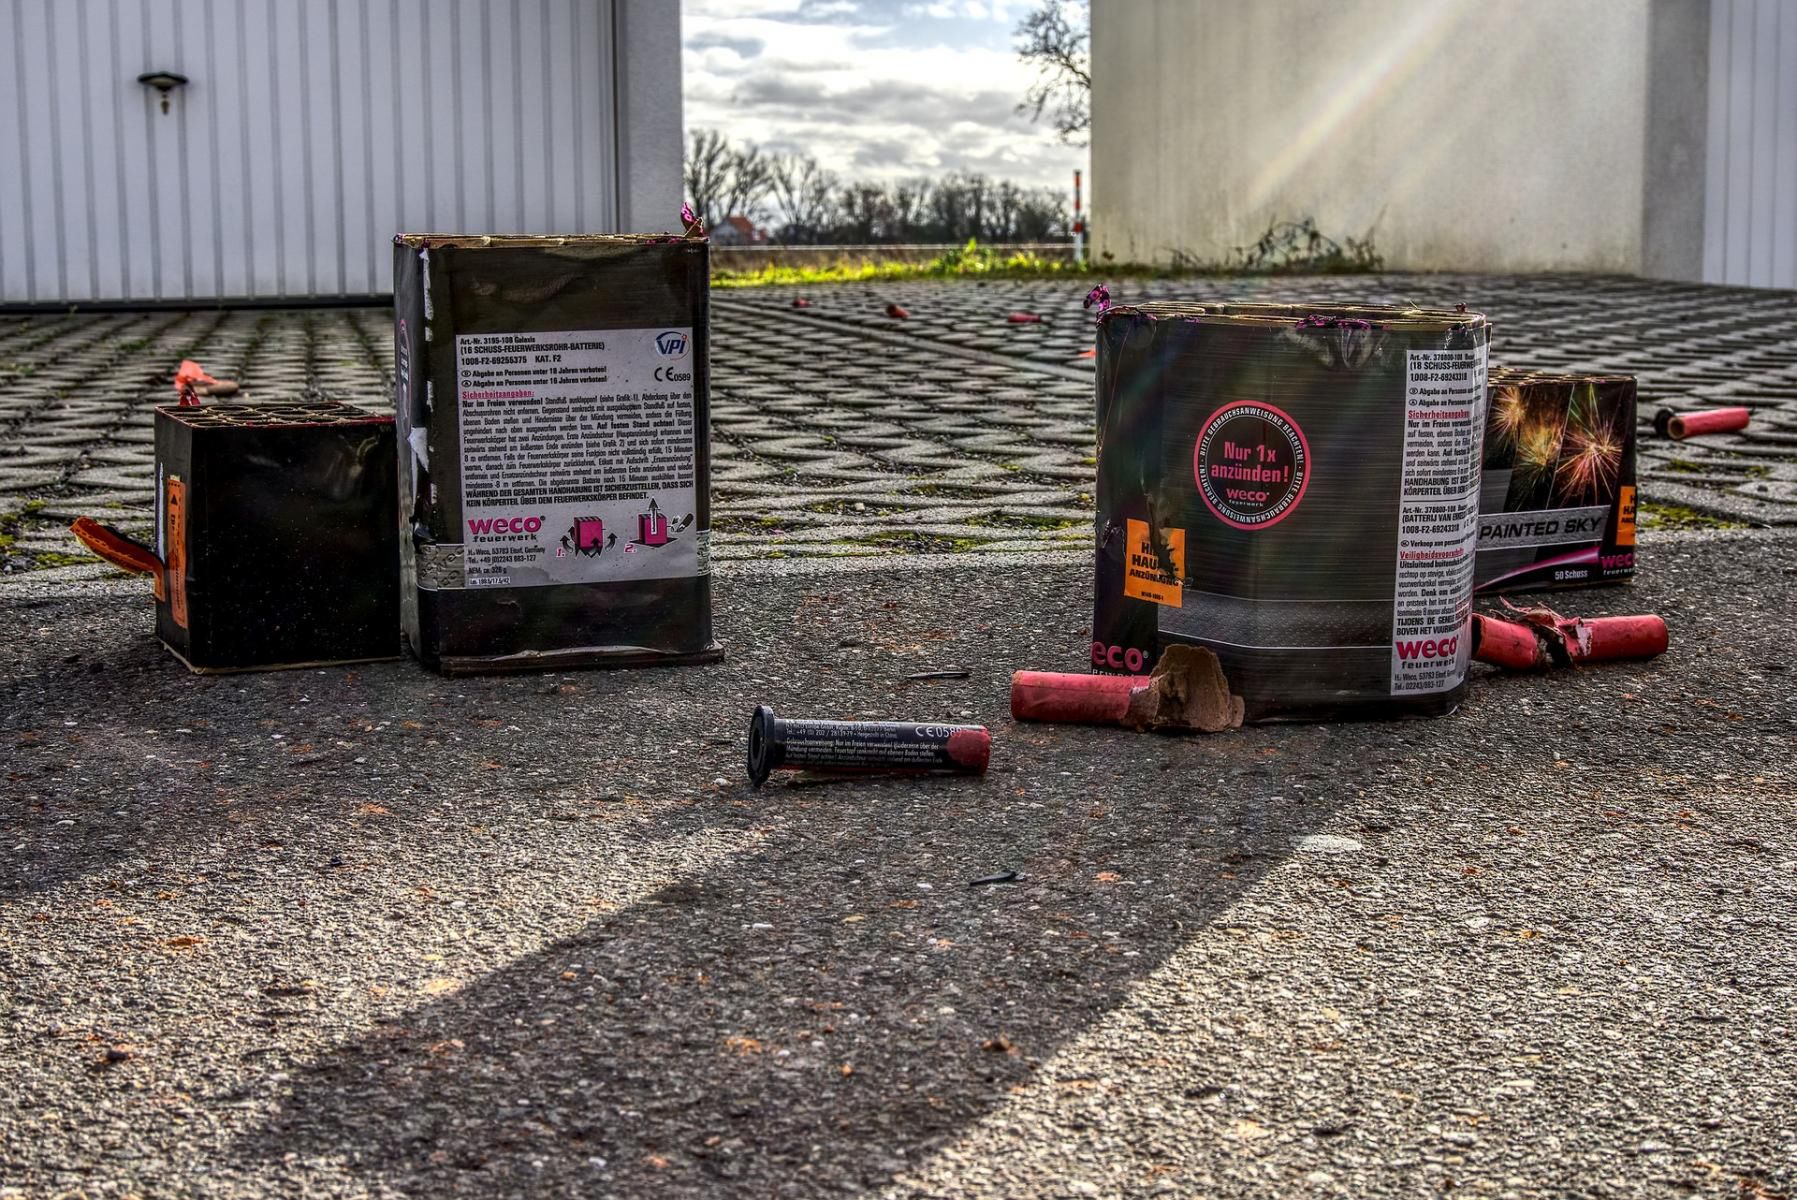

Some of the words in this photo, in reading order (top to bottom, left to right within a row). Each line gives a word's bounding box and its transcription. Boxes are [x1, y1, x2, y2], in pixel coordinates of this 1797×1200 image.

[1410, 362, 1422, 370] (18
[674, 373, 691, 382] 0589
[1200, 436, 1210, 456] BITTE
[1208, 407, 1283, 434] GEBRAUCHSANWEISUNG
[1282, 423, 1304, 463] BEACHTEN!
[1224, 442, 1251, 460] Nur
[1256, 445, 1276, 462] 1x
[1211, 464, 1281, 482] anzünden
[1200, 465, 1217, 505] BEACHTEN!
[1291, 472, 1303, 492] BITTE
[1226, 488, 1267, 501] weco
[1404, 487, 1441, 496] KÖRPERTEIL
[1443, 486, 1456, 495] ÜBER
[1217, 493, 1295, 523] GEBRAUCHSANWEISUNG
[468, 517, 541, 534] weco
[1402, 514, 1437, 523] (BATTERIJ
[1479, 521, 1558, 540] PAINTED
[1564, 517, 1602, 533] SKY
[473, 534, 537, 542] feuerwerk
[1555, 572, 1563, 580] 50
[1565, 570, 1588, 579] Schuss
[1396, 636, 1457, 660] weco
